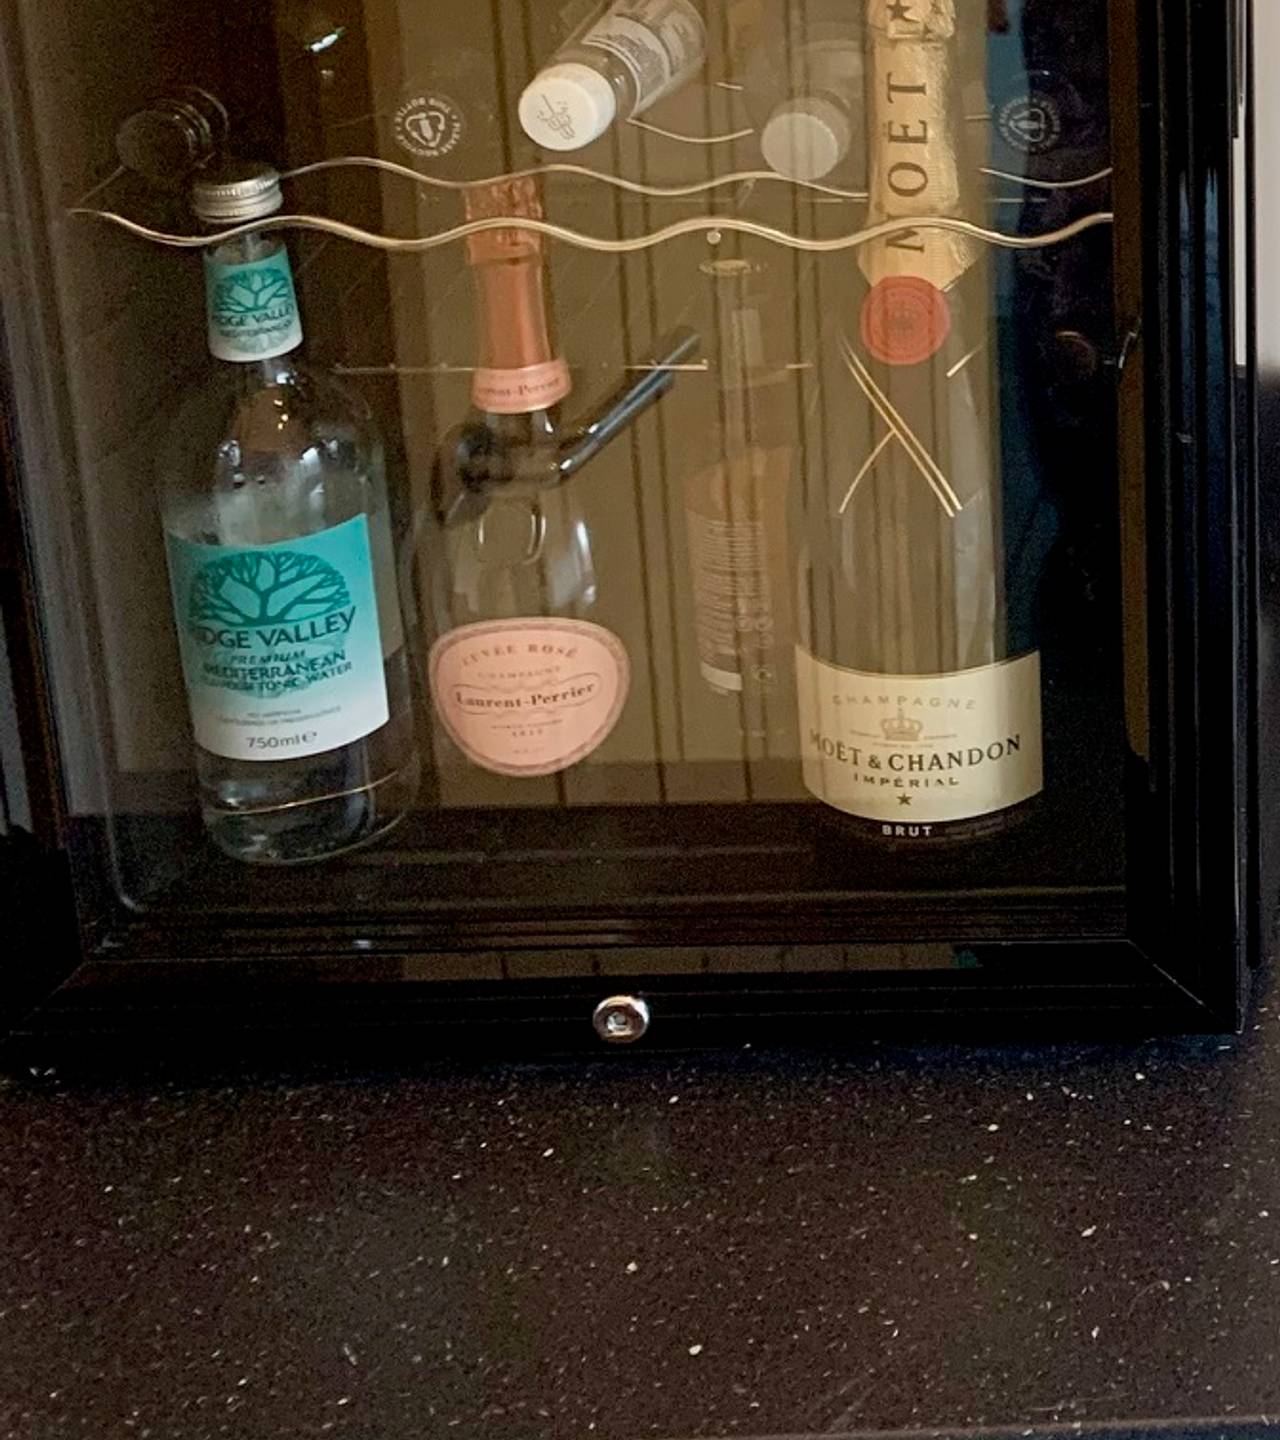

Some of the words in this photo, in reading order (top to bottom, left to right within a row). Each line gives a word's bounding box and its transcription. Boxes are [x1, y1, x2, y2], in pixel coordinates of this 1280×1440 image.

[256, 605, 356, 647] VALLEY
[202, 649, 346, 682] MEDITERRANEAN
[305, 661, 352, 684] WATER
[455, 682, 596, 709] Laurent-Perrier
[832, 694, 976, 710] CHAMPAGNE
[246, 735, 299, 749] 750ml
[868, 754, 882, 770] &
[887, 733, 1021, 772] CHANDON
[882, 825, 933, 837] BRUT
